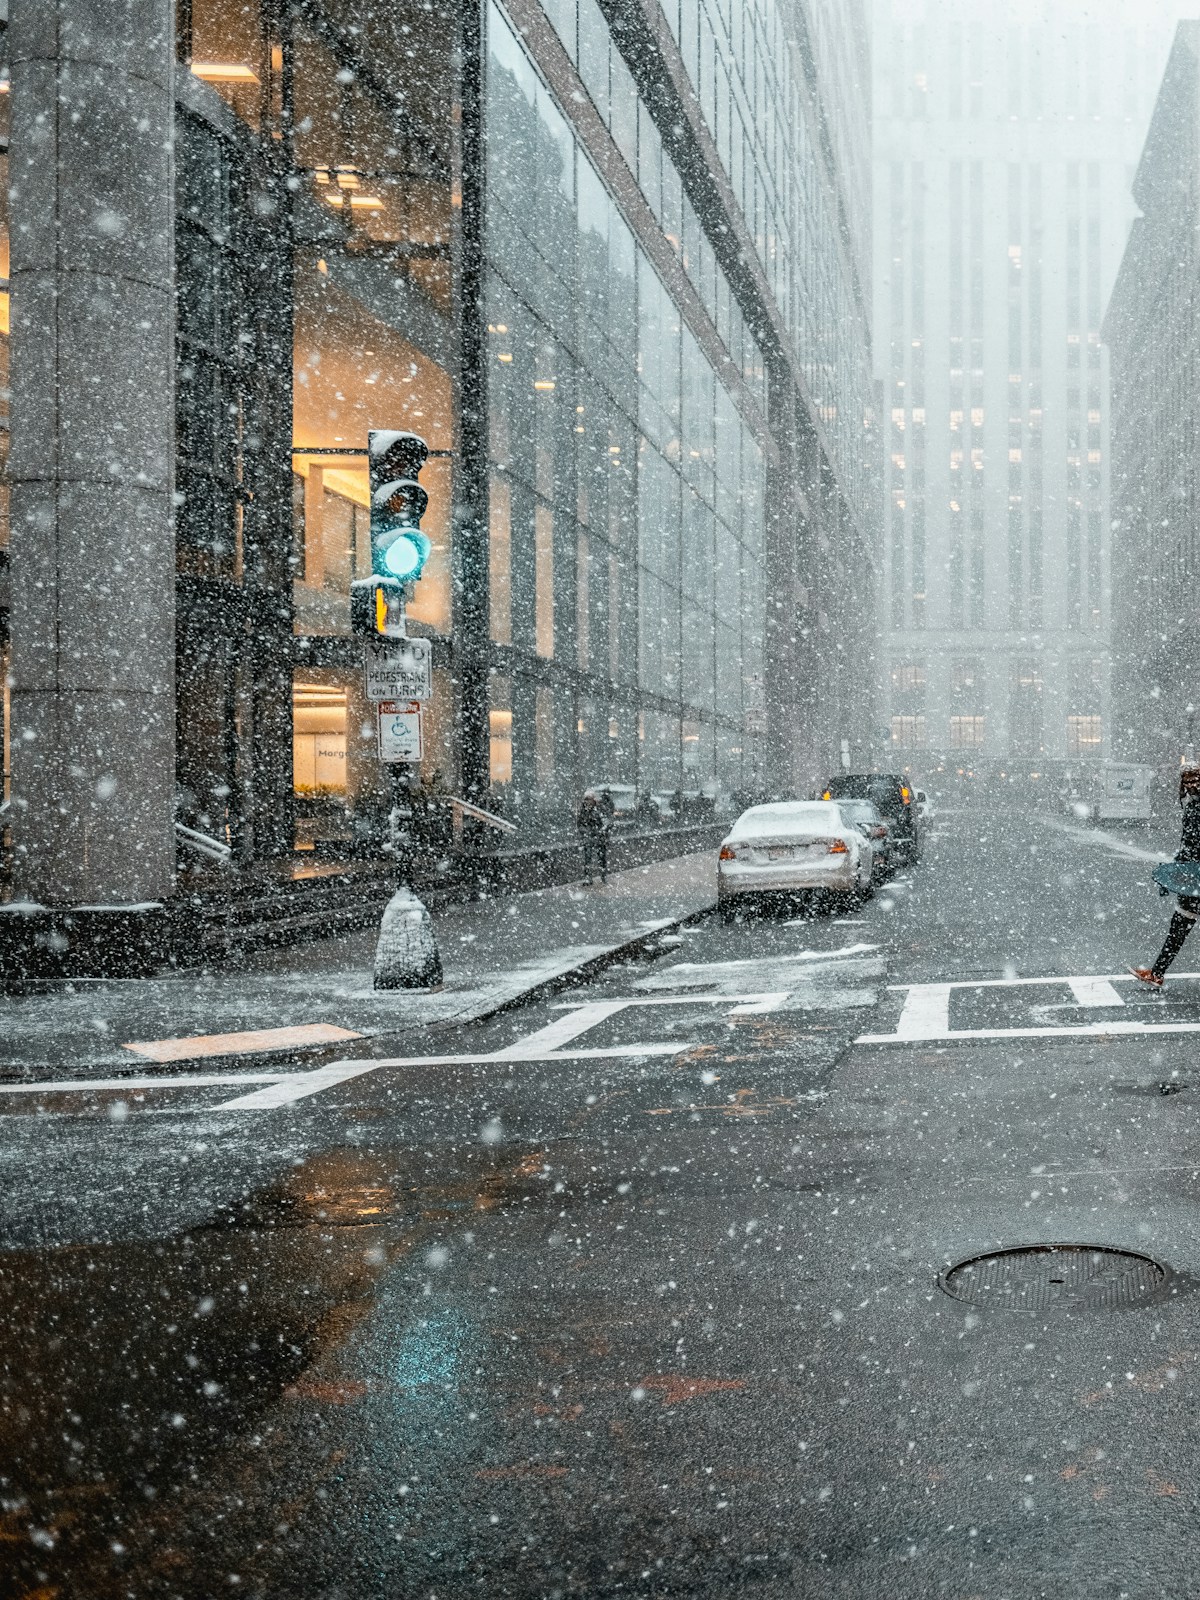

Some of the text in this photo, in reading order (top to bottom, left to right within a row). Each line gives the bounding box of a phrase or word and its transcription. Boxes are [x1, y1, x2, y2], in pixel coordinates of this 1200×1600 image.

[369, 671, 426, 683] PEDESTRIANS
[372, 684, 425, 696] ON TURNS
